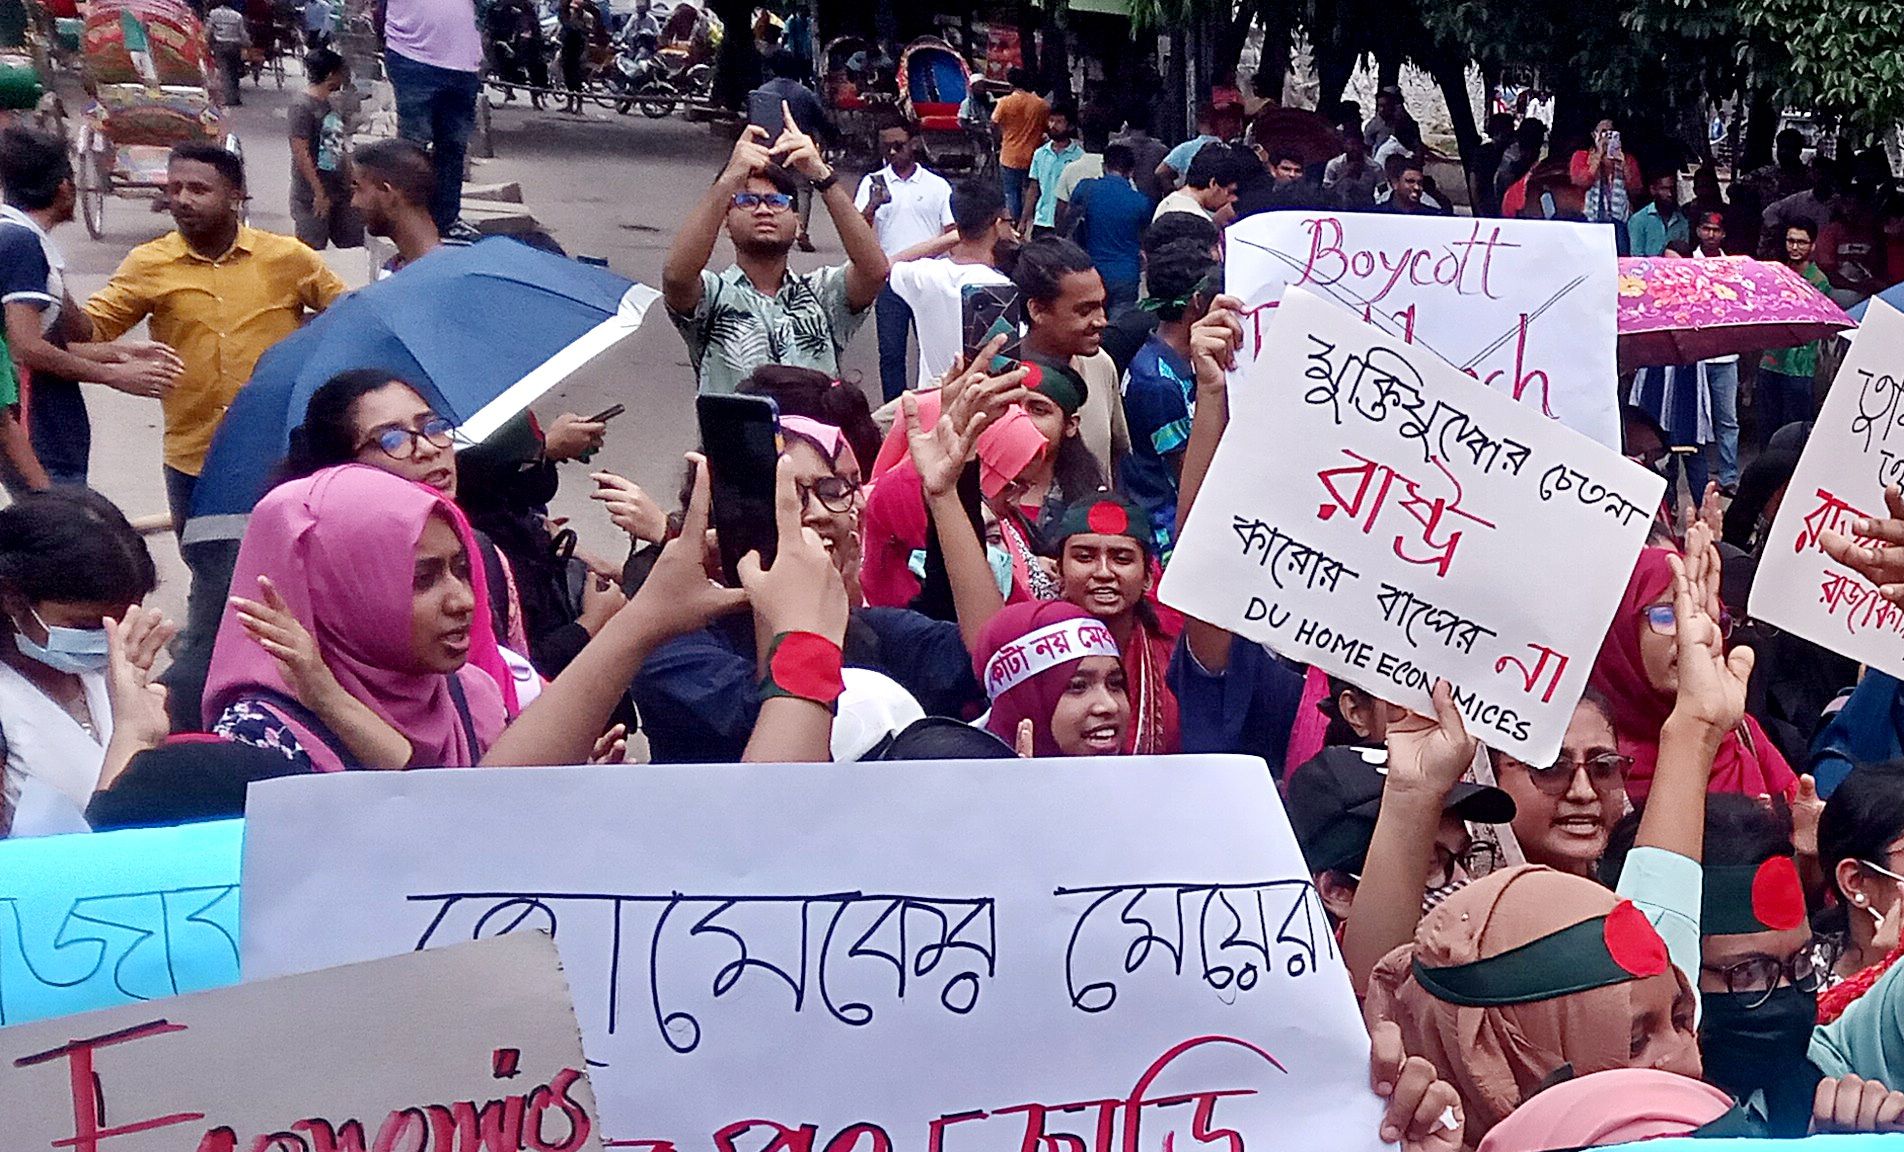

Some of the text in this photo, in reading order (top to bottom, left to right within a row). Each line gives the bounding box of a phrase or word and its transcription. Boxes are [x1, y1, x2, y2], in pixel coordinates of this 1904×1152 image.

[1297, 217, 1521, 305] Boycott
[1540, 463, 1649, 526] চেতনা
[1244, 596, 1532, 742] DU HOME ECONMICES
[1495, 643, 1570, 703] না
